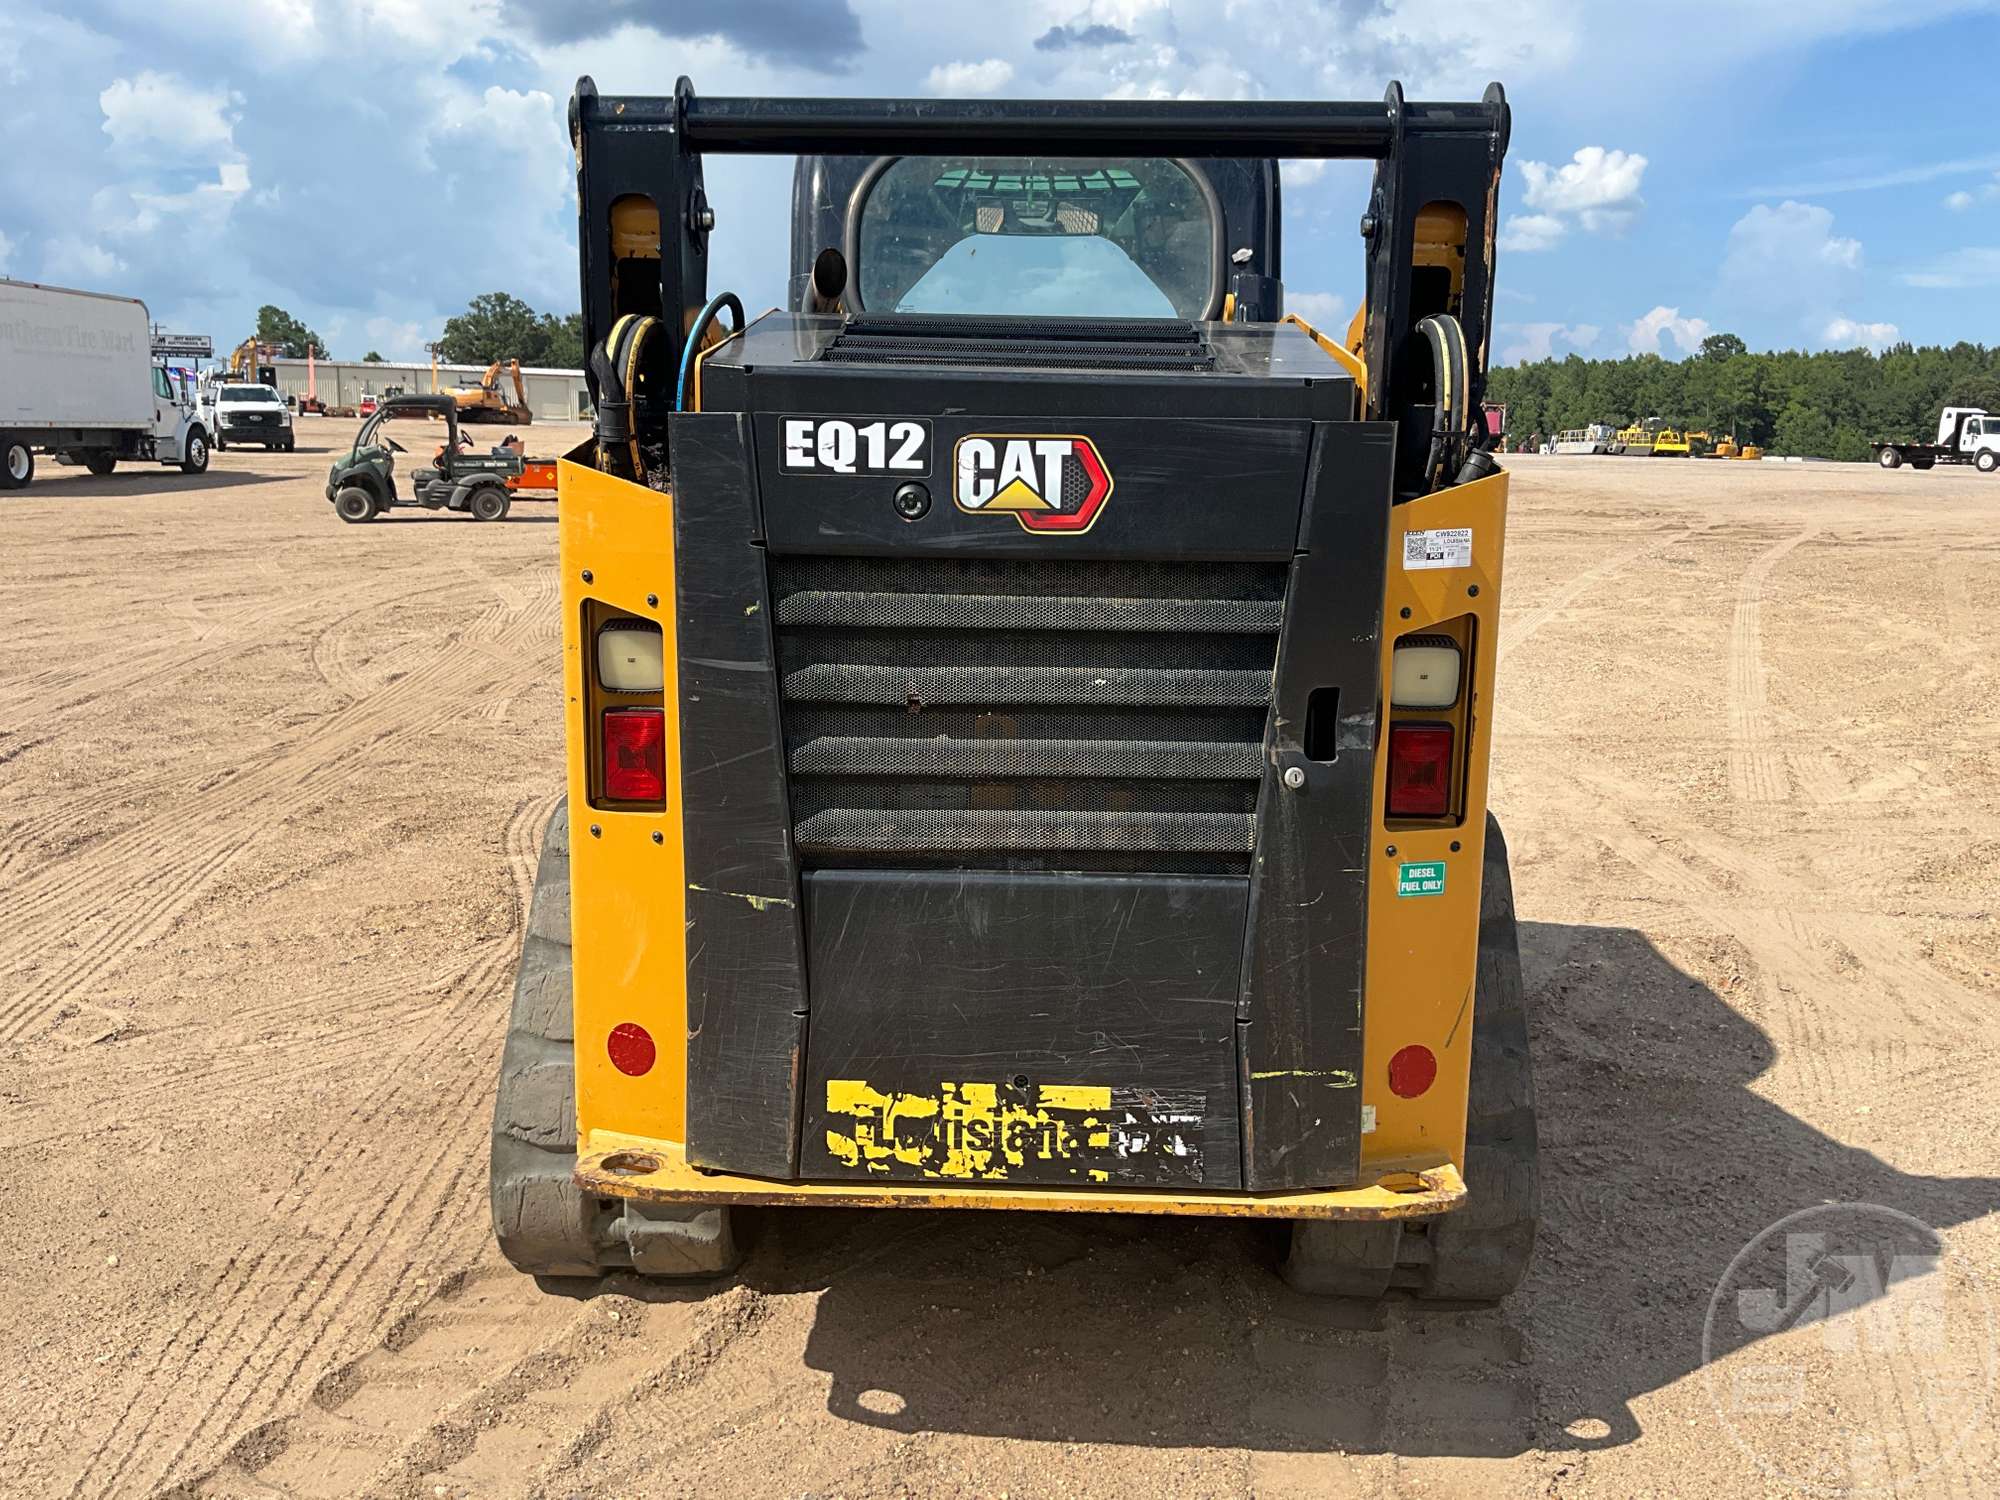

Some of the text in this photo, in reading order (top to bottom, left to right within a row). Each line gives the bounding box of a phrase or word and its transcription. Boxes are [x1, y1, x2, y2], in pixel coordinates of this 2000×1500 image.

[785, 420, 926, 473] EQ12
[958, 439, 1073, 510] CAT
[1401, 880, 1442, 892] FUEL ONLY
[1408, 868, 1436, 878] DIESEL
